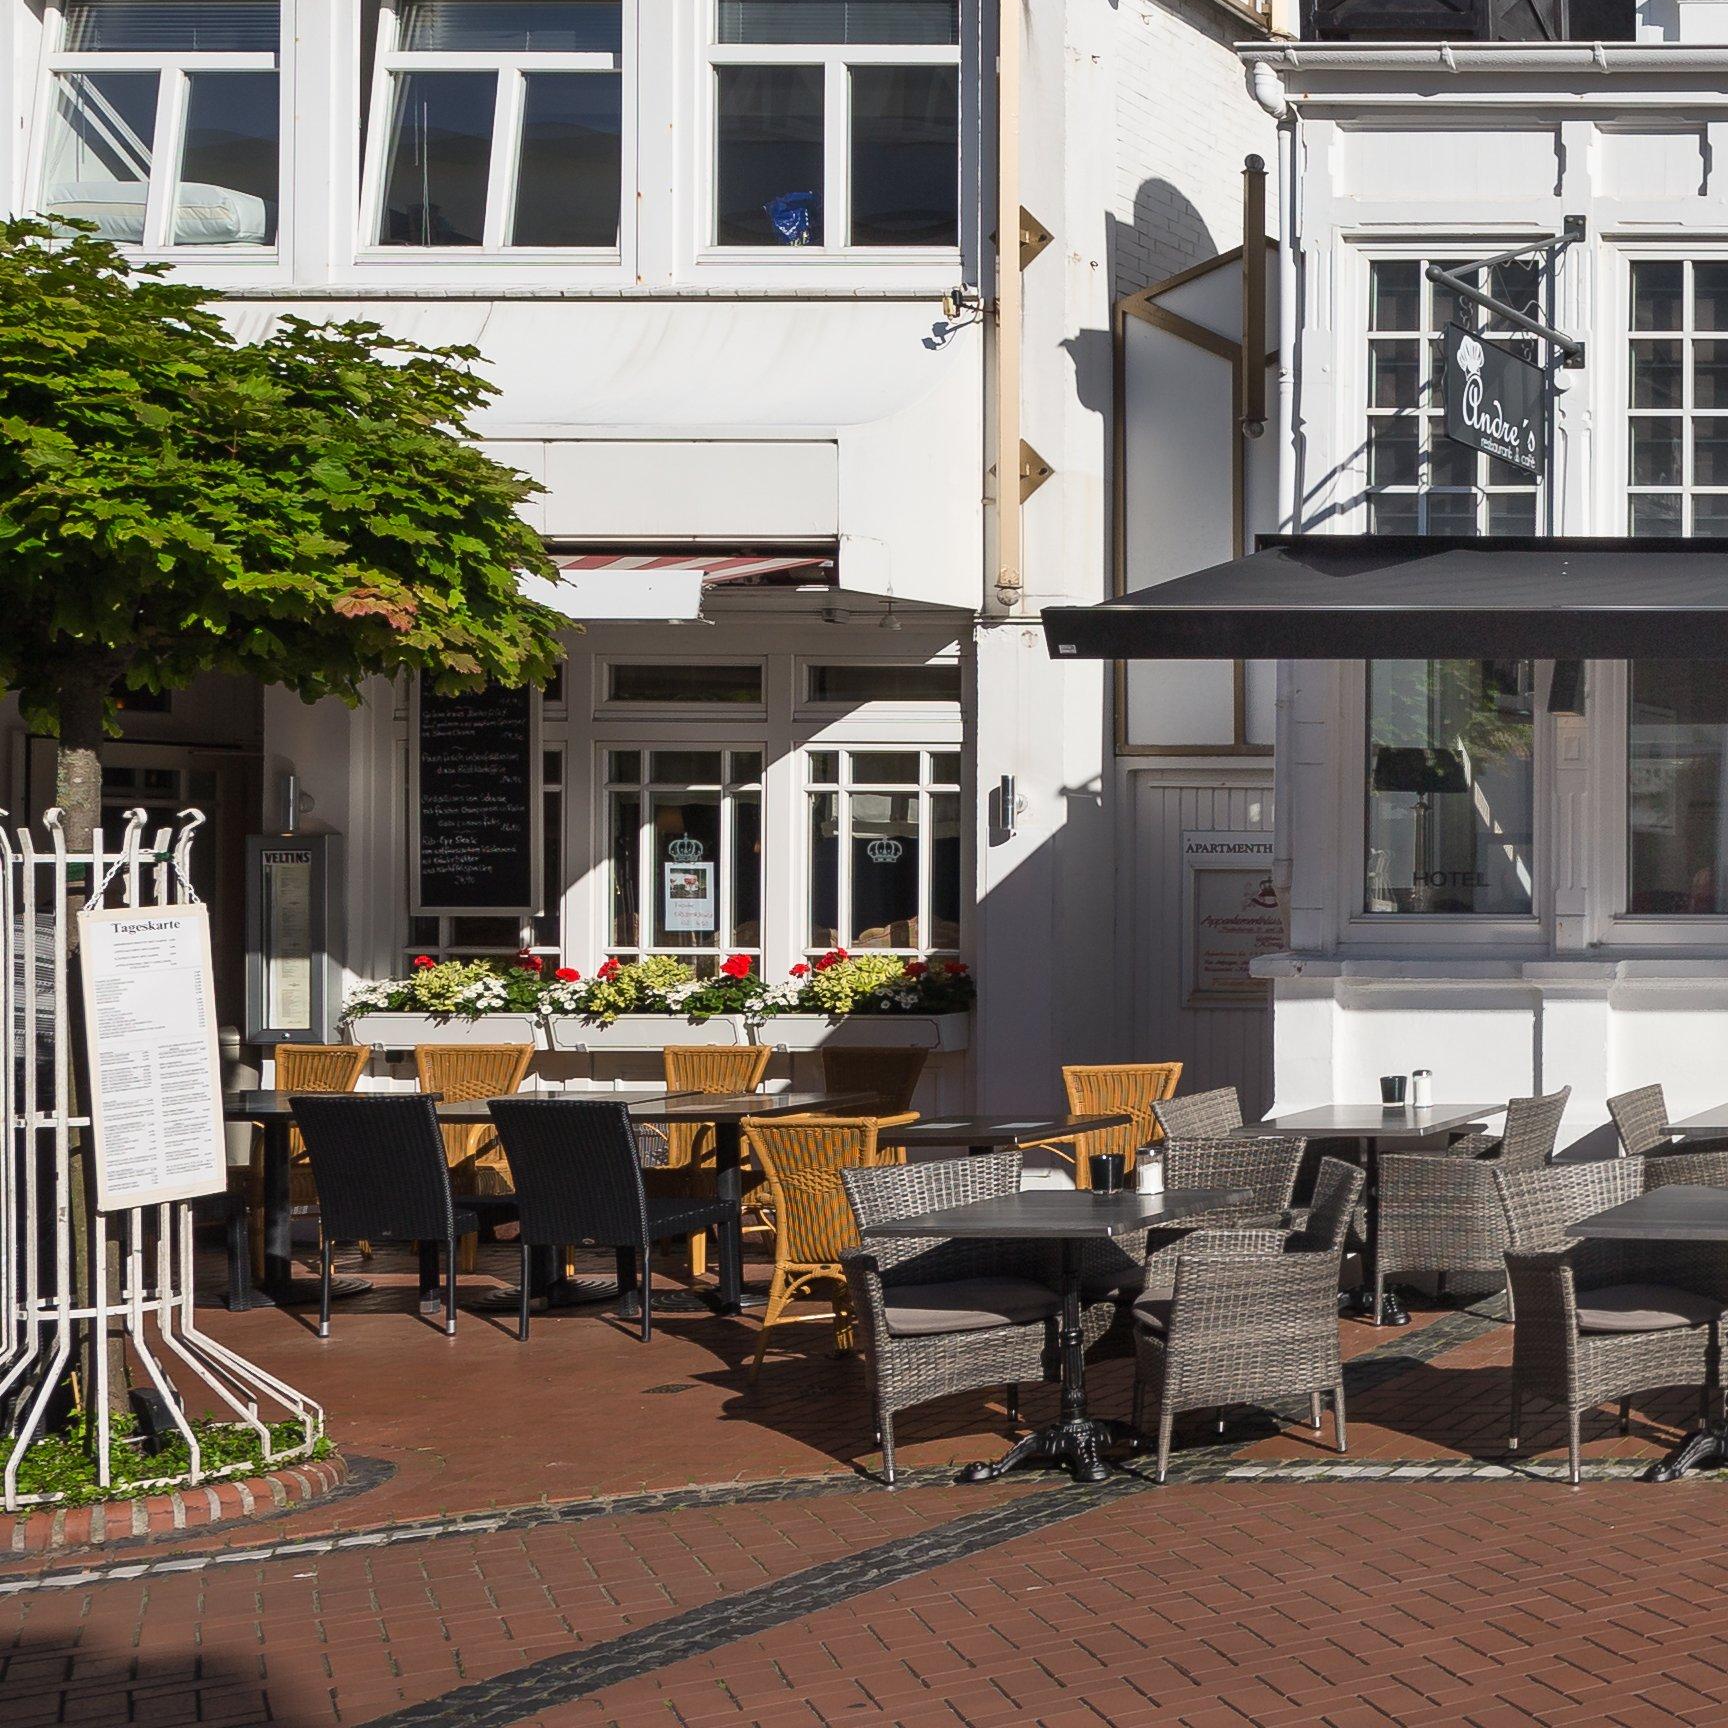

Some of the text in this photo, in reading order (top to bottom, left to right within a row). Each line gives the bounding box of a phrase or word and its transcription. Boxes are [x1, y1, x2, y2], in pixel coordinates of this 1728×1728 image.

[264, 850, 311, 864] VELTINS
[1413, 870, 1491, 888] HOTEL
[110, 918, 182, 935] Tageskarte
